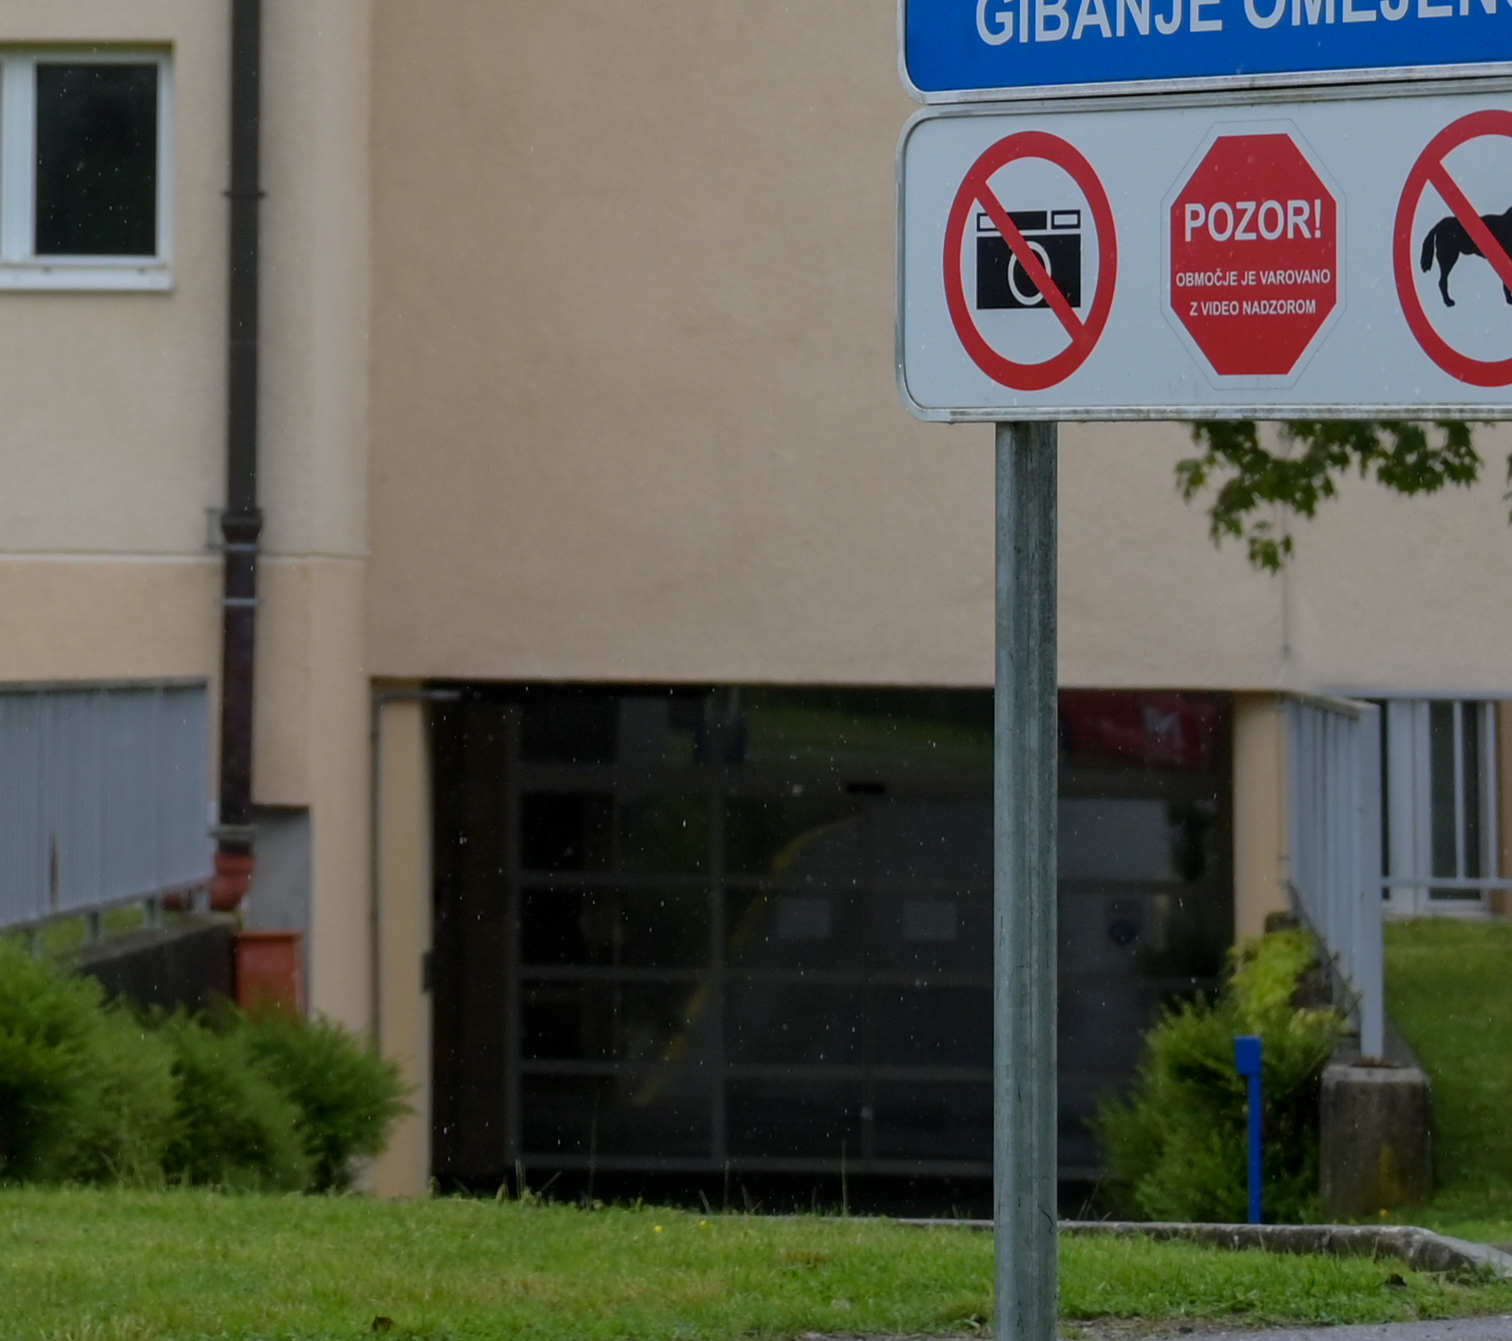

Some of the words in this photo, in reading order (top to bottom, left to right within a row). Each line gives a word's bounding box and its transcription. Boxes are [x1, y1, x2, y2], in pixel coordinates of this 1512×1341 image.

[1184, 199, 1322, 242] POZOR!
[1176, 268, 1238, 286] OBMOČJE
[1241, 270, 1257, 286] JE
[1259, 268, 1331, 286] VAROVANO
[1189, 301, 1199, 316] Z
[1201, 300, 1239, 316] VIDEO
[1243, 299, 1317, 316] NADZOROM
